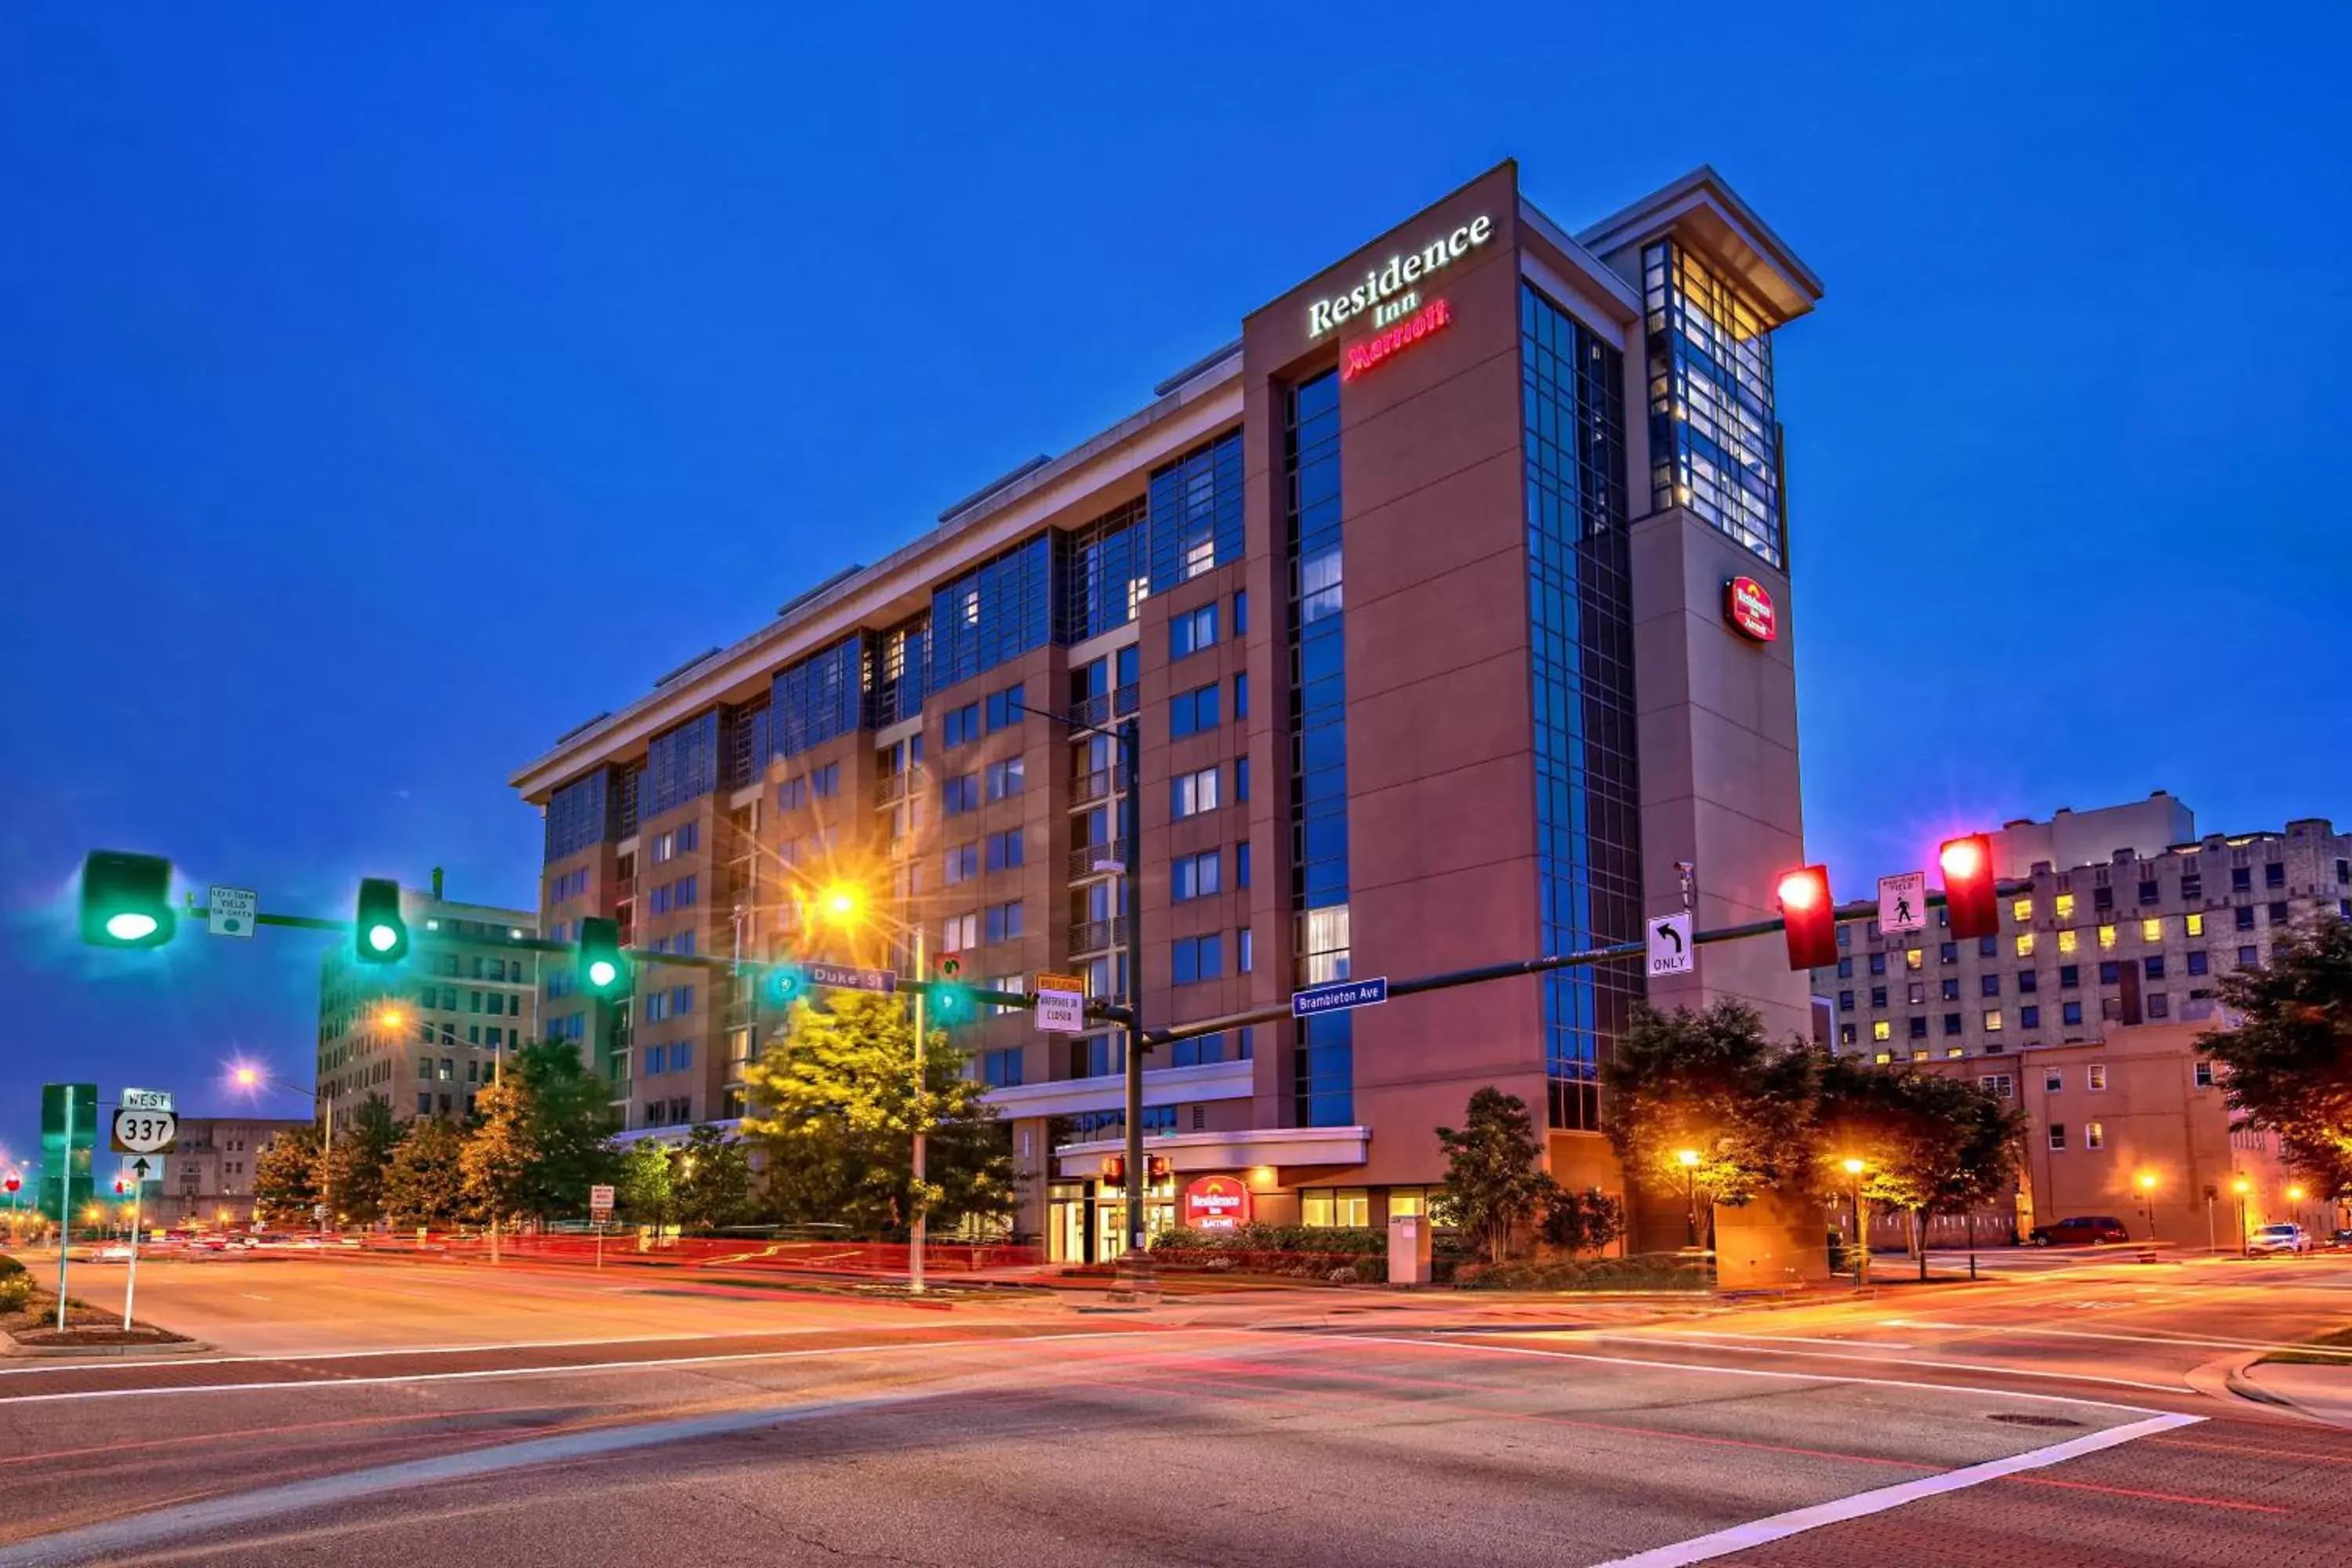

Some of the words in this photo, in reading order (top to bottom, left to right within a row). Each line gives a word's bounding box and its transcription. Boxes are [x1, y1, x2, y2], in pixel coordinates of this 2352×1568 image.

[1308, 215, 1491, 339] Residence
[1374, 292, 1417, 329] Inn
[1342, 299, 1448, 383] Marriott
[220, 899, 246, 909] YIELD
[1653, 956, 1686, 971] ONLY
[815, 968, 858, 985] Duke
[867, 974, 883, 986] St
[1299, 991, 1356, 1011] Brambleton
[1359, 986, 1379, 1000] Ave
[129, 1094, 165, 1106] WEST
[125, 1119, 168, 1142] 337
